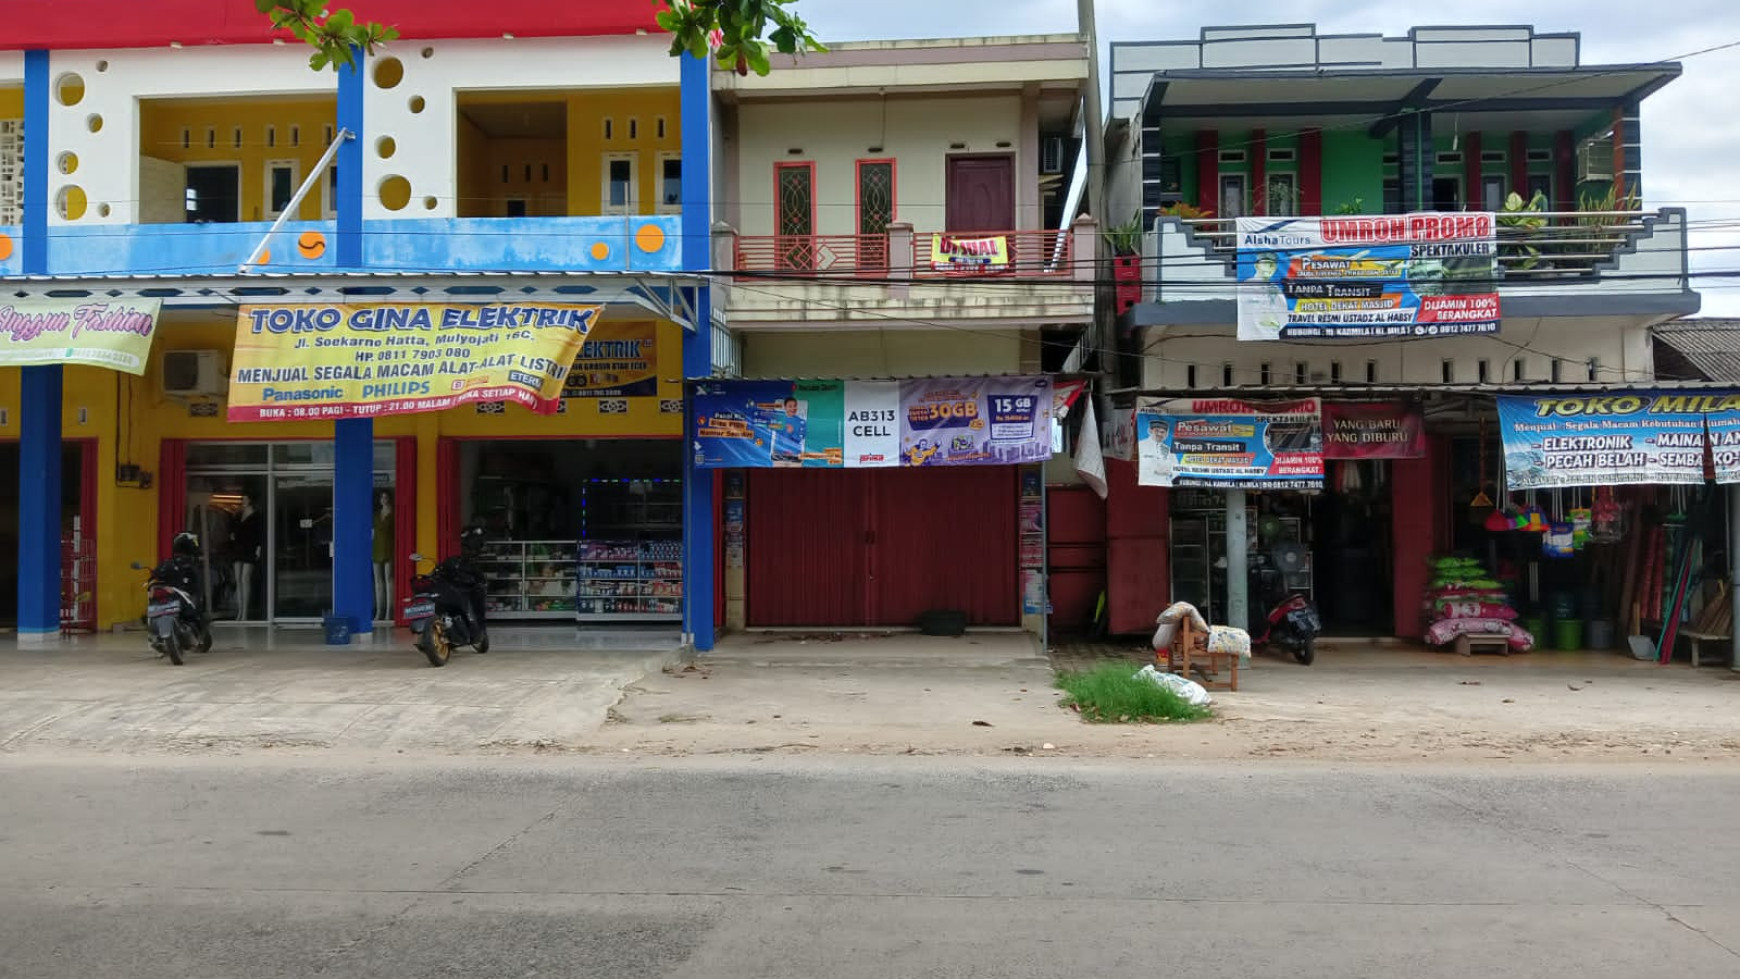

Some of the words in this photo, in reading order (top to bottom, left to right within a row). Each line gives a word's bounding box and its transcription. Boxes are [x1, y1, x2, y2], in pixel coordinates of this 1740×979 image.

[1321, 218, 1406, 244] UMROH
[1408, 215, 1490, 242] PROMO
[940, 236, 998, 256] DIJUAL
[1411, 243, 1490, 257] SPEKTAKULER
[1301, 256, 1351, 270] PESAWAT
[1326, 284, 1371, 297] TRANSIT
[1424, 301, 1467, 311] DIJAMIN
[1469, 297, 1497, 308] 100%
[250, 307, 342, 333] TOKO
[348, 306, 432, 331] GINA
[439, 305, 594, 335] ELEKTRIK
[1288, 313, 1316, 323] TRAVEL
[1317, 313, 1341, 323] RESMI
[1342, 313, 1374, 323] USTADZ
[1387, 312, 1414, 322] HABSY
[1436, 308, 1497, 320] BERANGKAT
[314, 336, 382, 347] Soekarno
[435, 332, 499, 347] Mulyojati
[354, 351, 375, 362] HP.
[377, 350, 407, 361] 0811
[412, 348, 442, 360] 7903
[446, 347, 471, 358] 080
[237, 367, 309, 384] MENJUAL
[313, 365, 372, 381] SEGALA
[376, 361, 435, 378] MACAM
[437, 353, 516, 375] ALAT-ALAT
[262, 385, 344, 401] Panasonic
[362, 380, 430, 399] PHILIPS
[259, 408, 286, 419] BUKA
[293, 407, 320, 417] 08.00
[322, 406, 344, 416] PAGI
[353, 404, 382, 414] TUTUP
[389, 401, 415, 411] 21.00
[417, 397, 450, 410] MALAM
[481, 388, 516, 399] SETIAP
[928, 401, 977, 420] 30GB
[994, 398, 1012, 413] 15
[1015, 397, 1032, 408] GB
[1536, 396, 1643, 417] TOKO
[848, 409, 895, 422] AB313
[853, 425, 891, 437] CELL
[1178, 421, 1232, 432] Pesawat
[1333, 419, 1364, 430] YANG
[1368, 419, 1400, 430] BARU
[1514, 422, 1556, 433] Menjual
[1565, 420, 1599, 431] Segala
[1601, 420, 1639, 429] Macam
[1641, 419, 1698, 429] Kebutuhan
[1327, 432, 1358, 443] YANG
[1362, 432, 1408, 443] DIBURU
[1543, 435, 1632, 451] ELEKTRONIK
[1174, 442, 1202, 453] Tanpa
[1207, 442, 1240, 452] Transit
[1545, 453, 1595, 470] PECAH
[1596, 451, 1646, 468] BELAH
